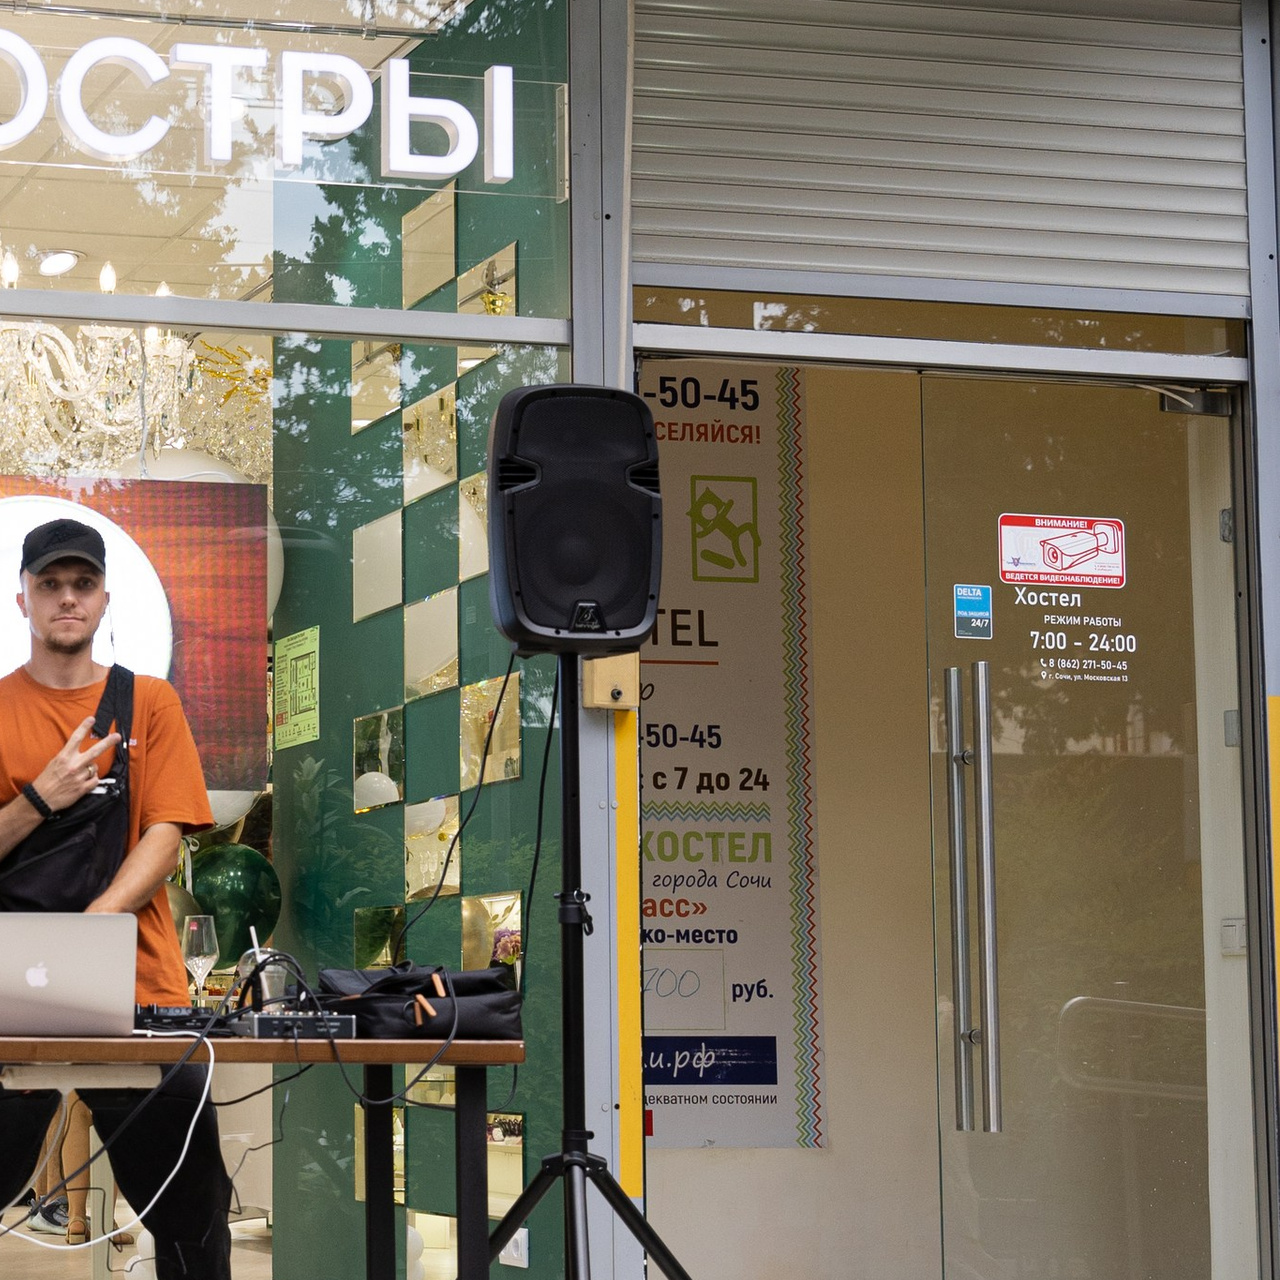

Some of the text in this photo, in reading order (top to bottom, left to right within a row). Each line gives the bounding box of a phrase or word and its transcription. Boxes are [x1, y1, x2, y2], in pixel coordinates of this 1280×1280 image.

[1035, 518, 1088, 529] ВНИМАНИЕ!
[1005, 572, 1121, 585] ВЕДЕТСЯ ВИДЕОНАБЛЮДЕНИЕ!
[956, 587, 982, 597] DELTA
[1014, 586, 1082, 608] Хостел
[971, 618, 990, 628] 24/7
[1044, 614, 1122, 627] РЕЖИМ РАБОТЫ
[1030, 631, 1067, 650] 7:00
[1088, 633, 1137, 653] 24:00
[1048, 658, 1128, 671] 8 (862) 271-50-45
[1054, 673, 1073, 681] Сочи,
[1083, 673, 1121, 682] Московская
[1121, 674, 1129, 682] 13
[673, 767, 689, 790] 7
[695, 772, 730, 794] до
[738, 768, 770, 791] 24
[652, 868, 772, 894] города Сочи
[731, 978, 774, 1003] руб.
[711, 1094, 778, 1105] состоянии
